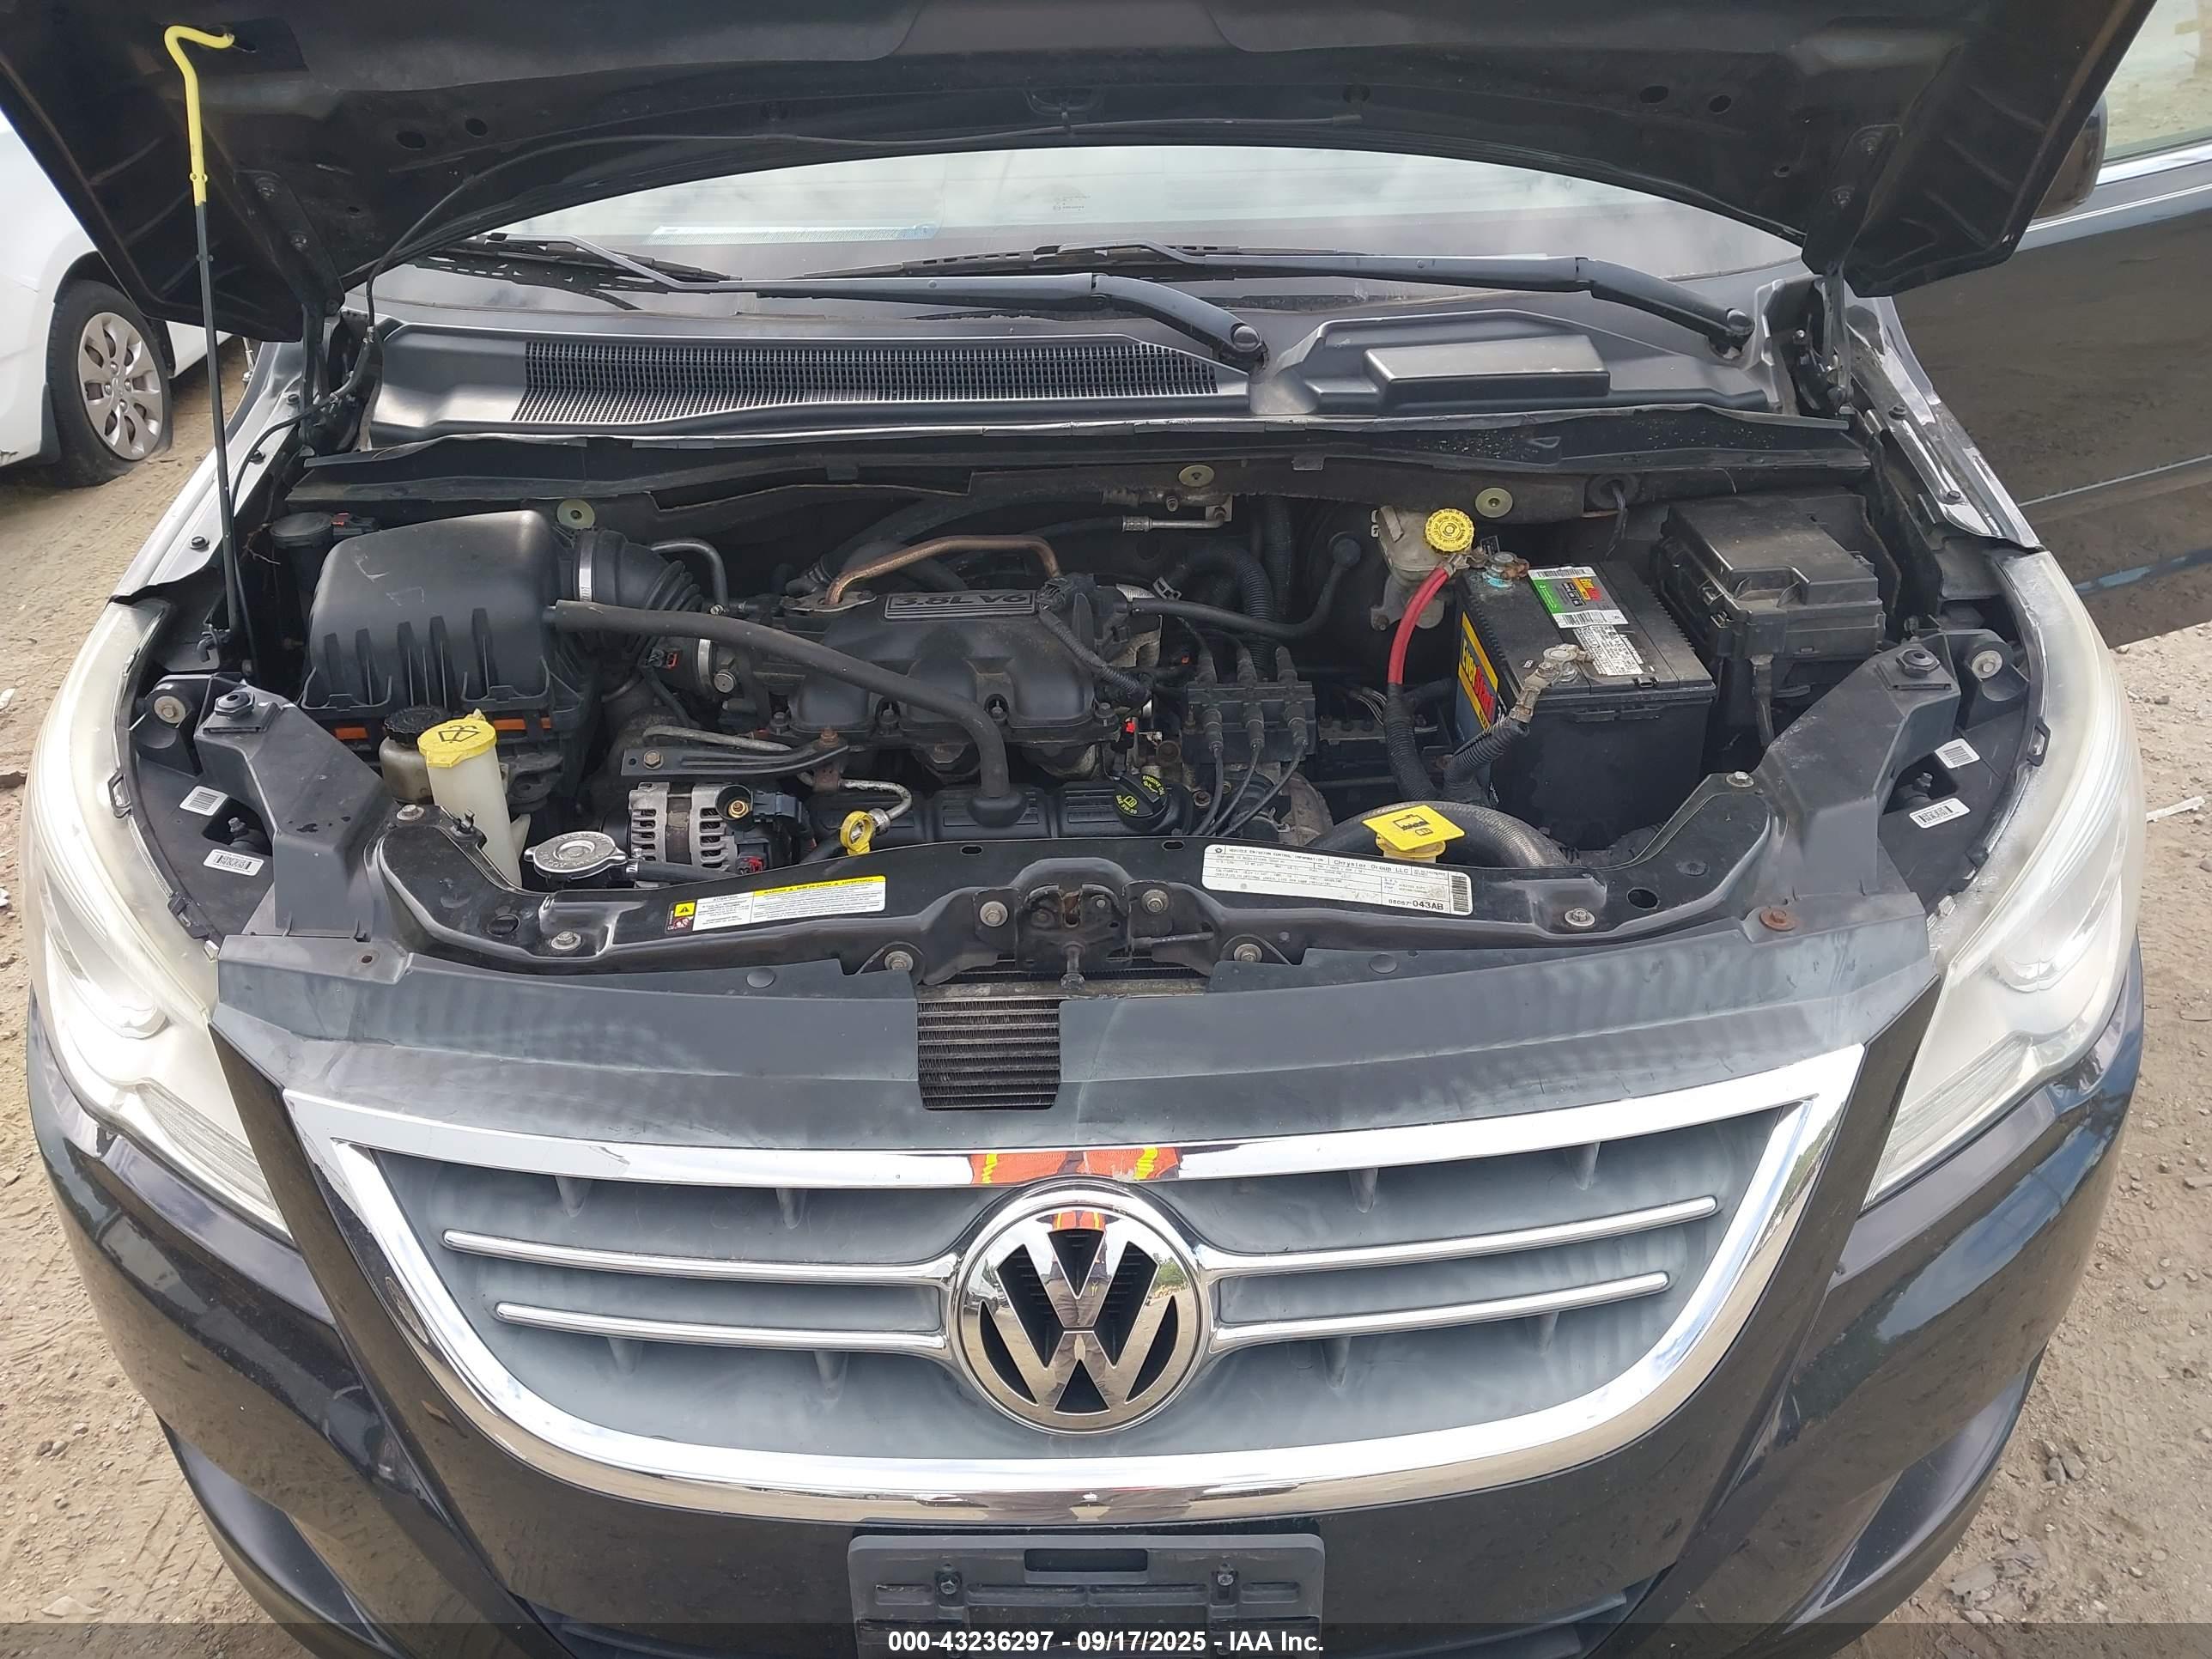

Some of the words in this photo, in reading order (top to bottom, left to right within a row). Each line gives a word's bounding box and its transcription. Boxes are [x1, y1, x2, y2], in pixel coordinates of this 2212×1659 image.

[895, 595, 973, 606] 3.8L
[979, 593, 1027, 603] V6
[1142, 775, 1161, 787] ENGINE
[1334, 859, 1366, 867] Chrysler
[1370, 864, 1392, 873] Group
